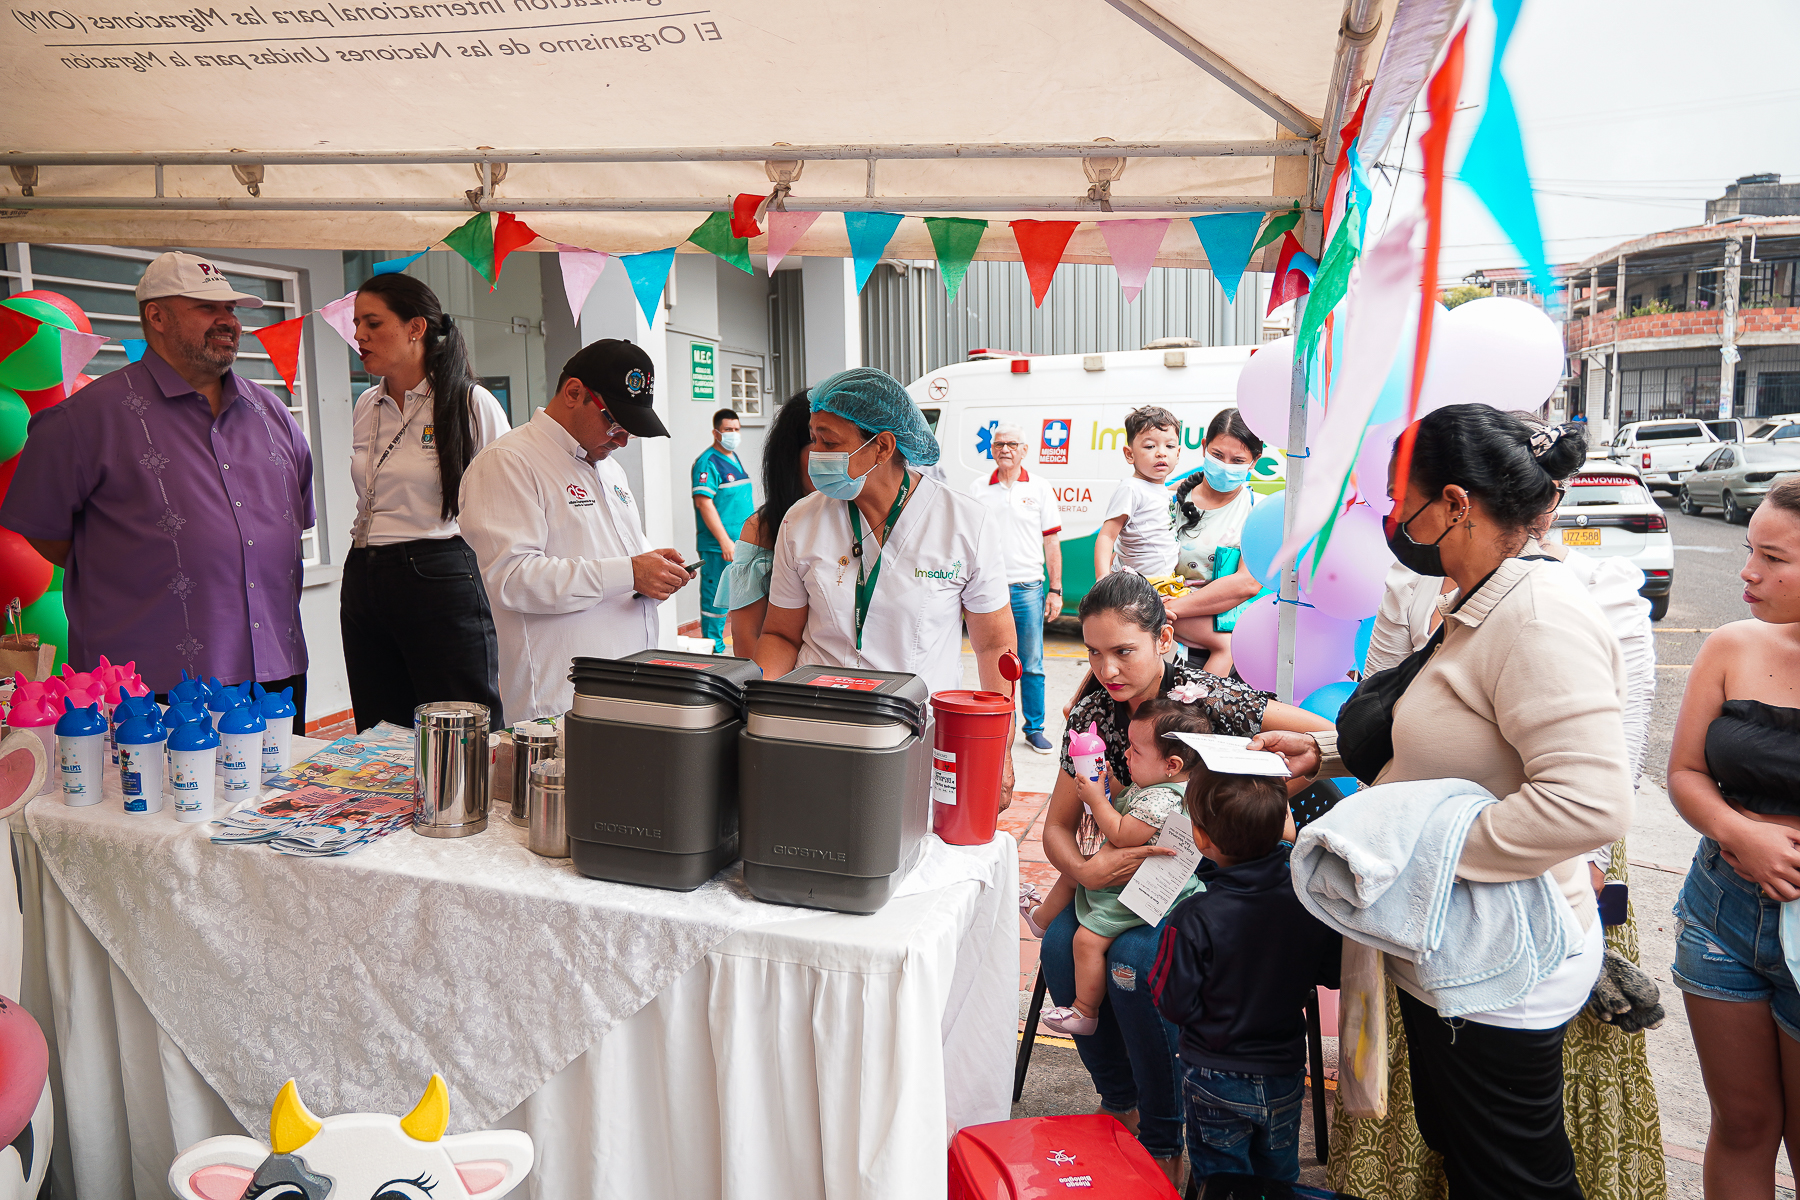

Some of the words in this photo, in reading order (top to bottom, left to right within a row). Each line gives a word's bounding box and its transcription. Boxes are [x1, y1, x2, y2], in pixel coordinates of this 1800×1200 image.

[1042, 446, 1067, 455] MISIÓN
[914, 567, 955, 580] Imsalud
[594, 821, 662, 839] GIO'STYLE
[773, 844, 846, 862] GIO'STYLE
